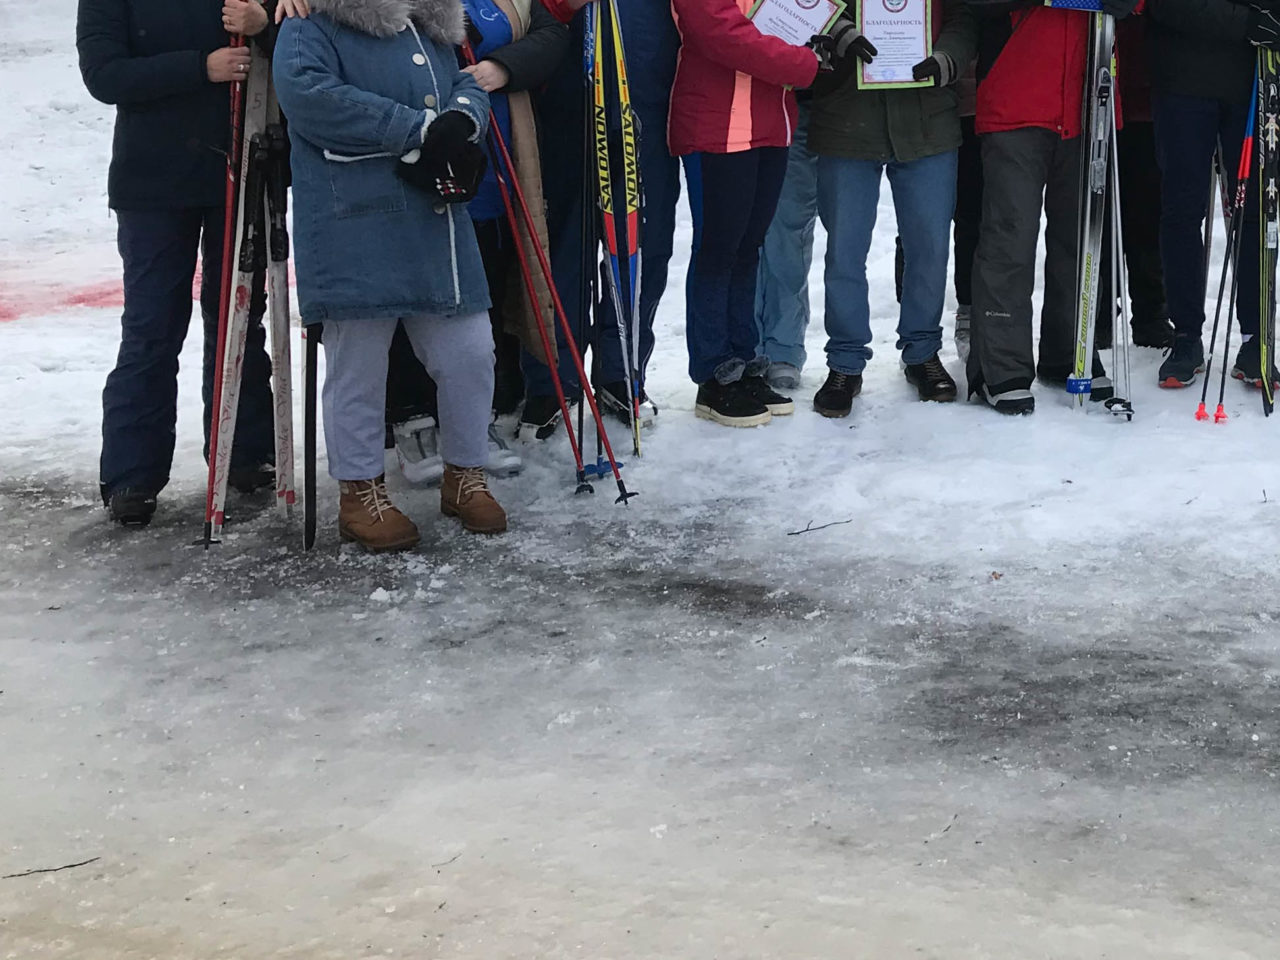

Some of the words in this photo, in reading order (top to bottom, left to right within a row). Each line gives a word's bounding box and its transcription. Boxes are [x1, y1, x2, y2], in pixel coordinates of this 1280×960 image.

[252, 93, 262, 109] 5
[595, 104, 613, 212] SALOMON
[620, 102, 637, 208] SALOMON
